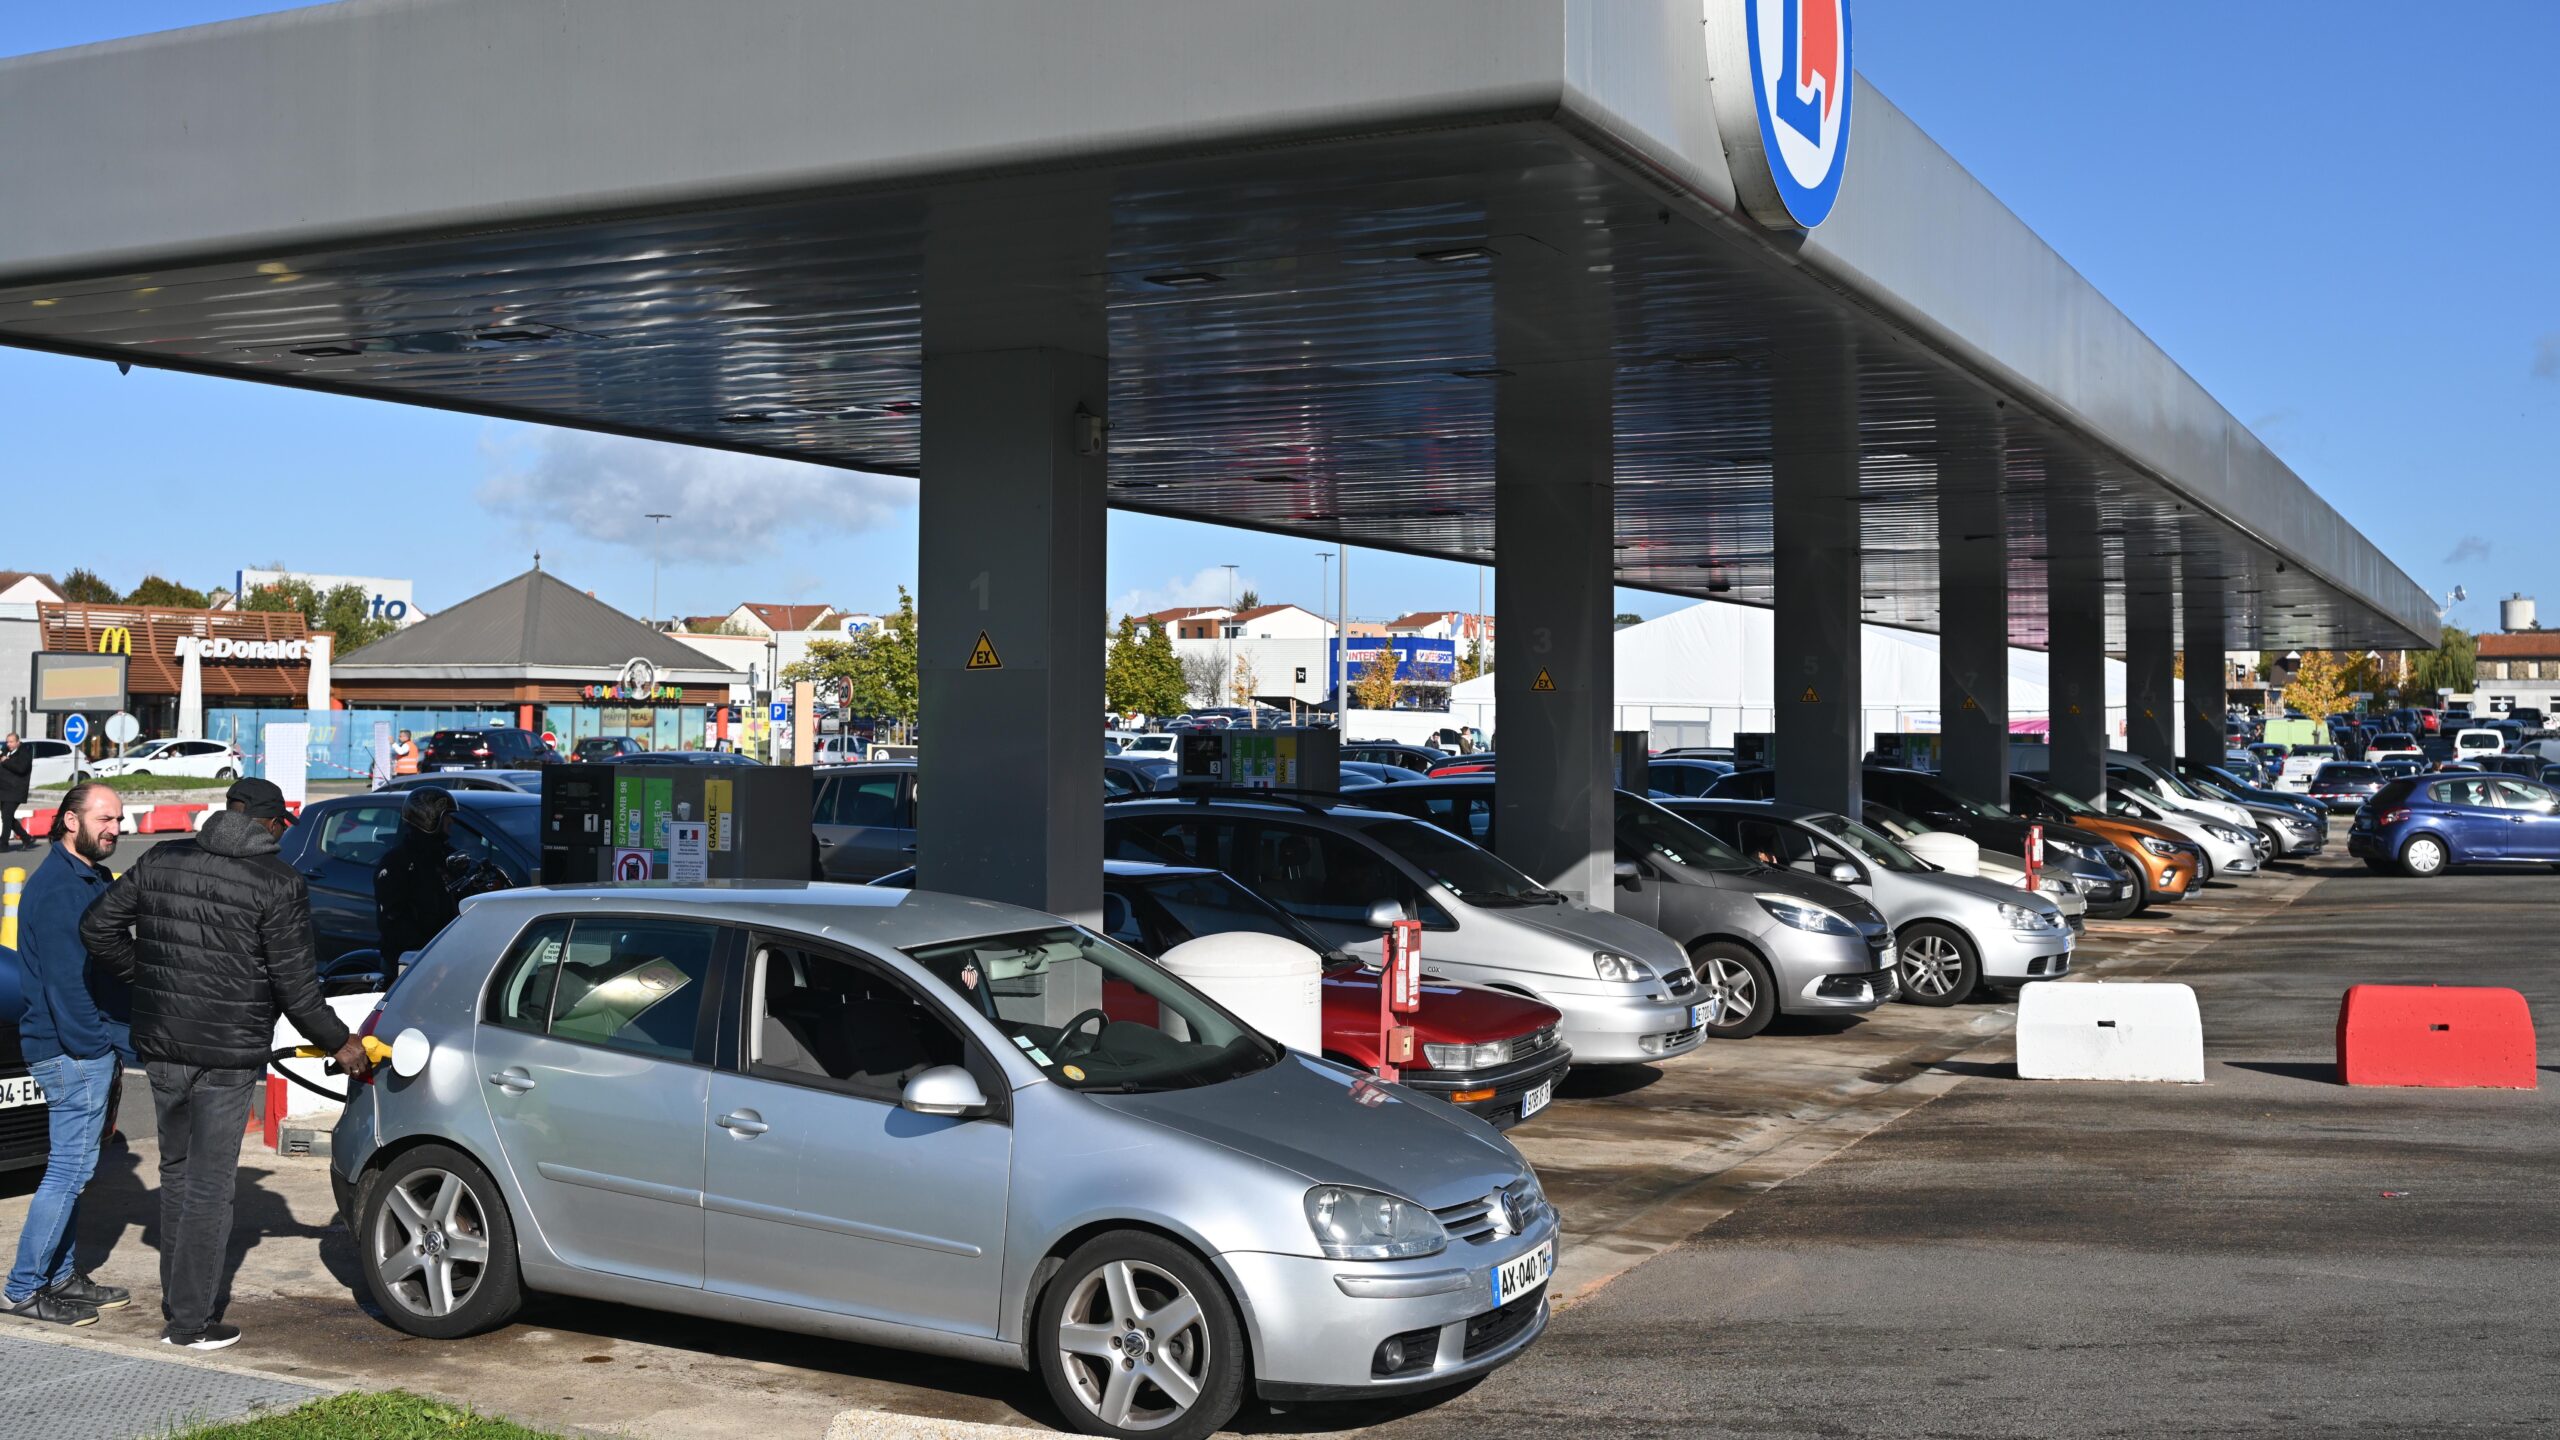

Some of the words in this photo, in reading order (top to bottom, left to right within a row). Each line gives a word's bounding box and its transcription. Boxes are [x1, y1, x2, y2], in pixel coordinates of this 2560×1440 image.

[969, 571, 990, 611] 1
[364, 594, 407, 620] to
[1532, 627, 1552, 654] 3
[976, 650, 991, 664] EX
[1803, 655, 1819, 674] 5
[584, 685, 632, 699] RONALD
[651, 686, 682, 699] LAND
[841, 685, 849, 699] 20
[1538, 680, 1550, 688] EX
[603, 712, 626, 721] HAPPY
[630, 712, 648, 721] MEAL
[773, 705, 783, 719] P
[1212, 762, 1219, 772] 3
[620, 781, 628, 793] 98
[588, 814, 594, 831] 1
[619, 796, 627, 845] S/PLOMB
[653, 799, 662, 846] SP95-E10
[708, 805, 717, 848] GAZOLE
[1502, 1247, 1548, 1297] AX-040-TH
